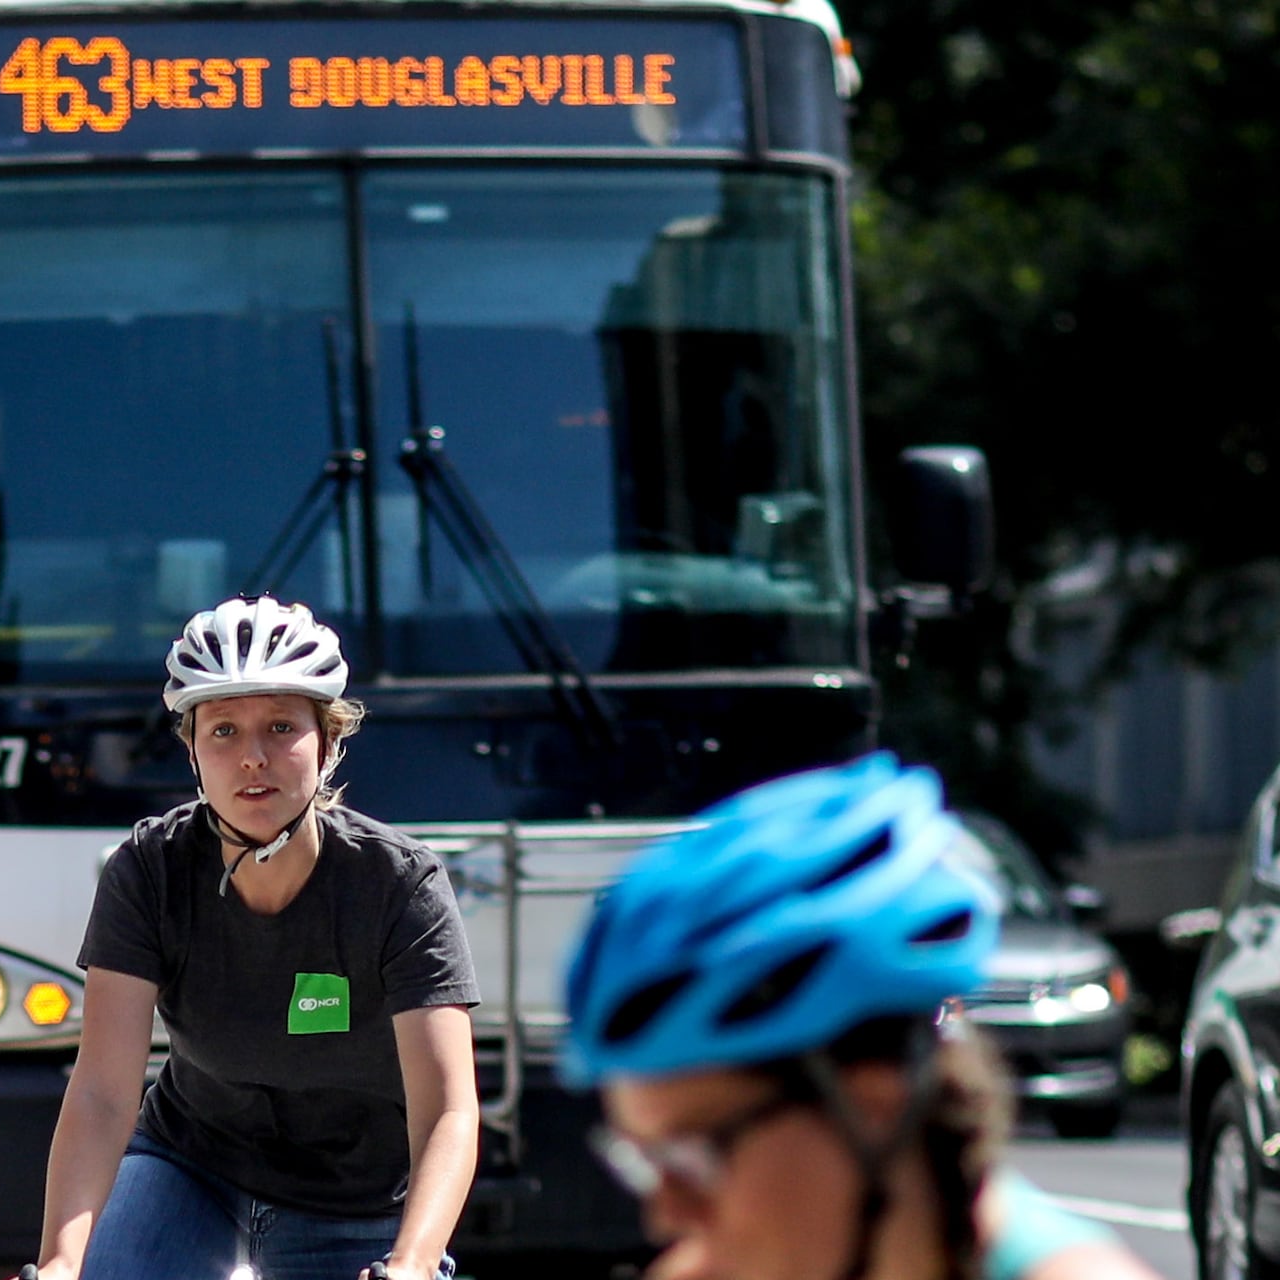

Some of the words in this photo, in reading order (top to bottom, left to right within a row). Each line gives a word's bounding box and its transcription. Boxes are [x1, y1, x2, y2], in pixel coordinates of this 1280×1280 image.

[132, 58, 270, 108] WEST
[289, 54, 676, 107] DOUGLASVILLE
[317, 997, 340, 1007] NCR
